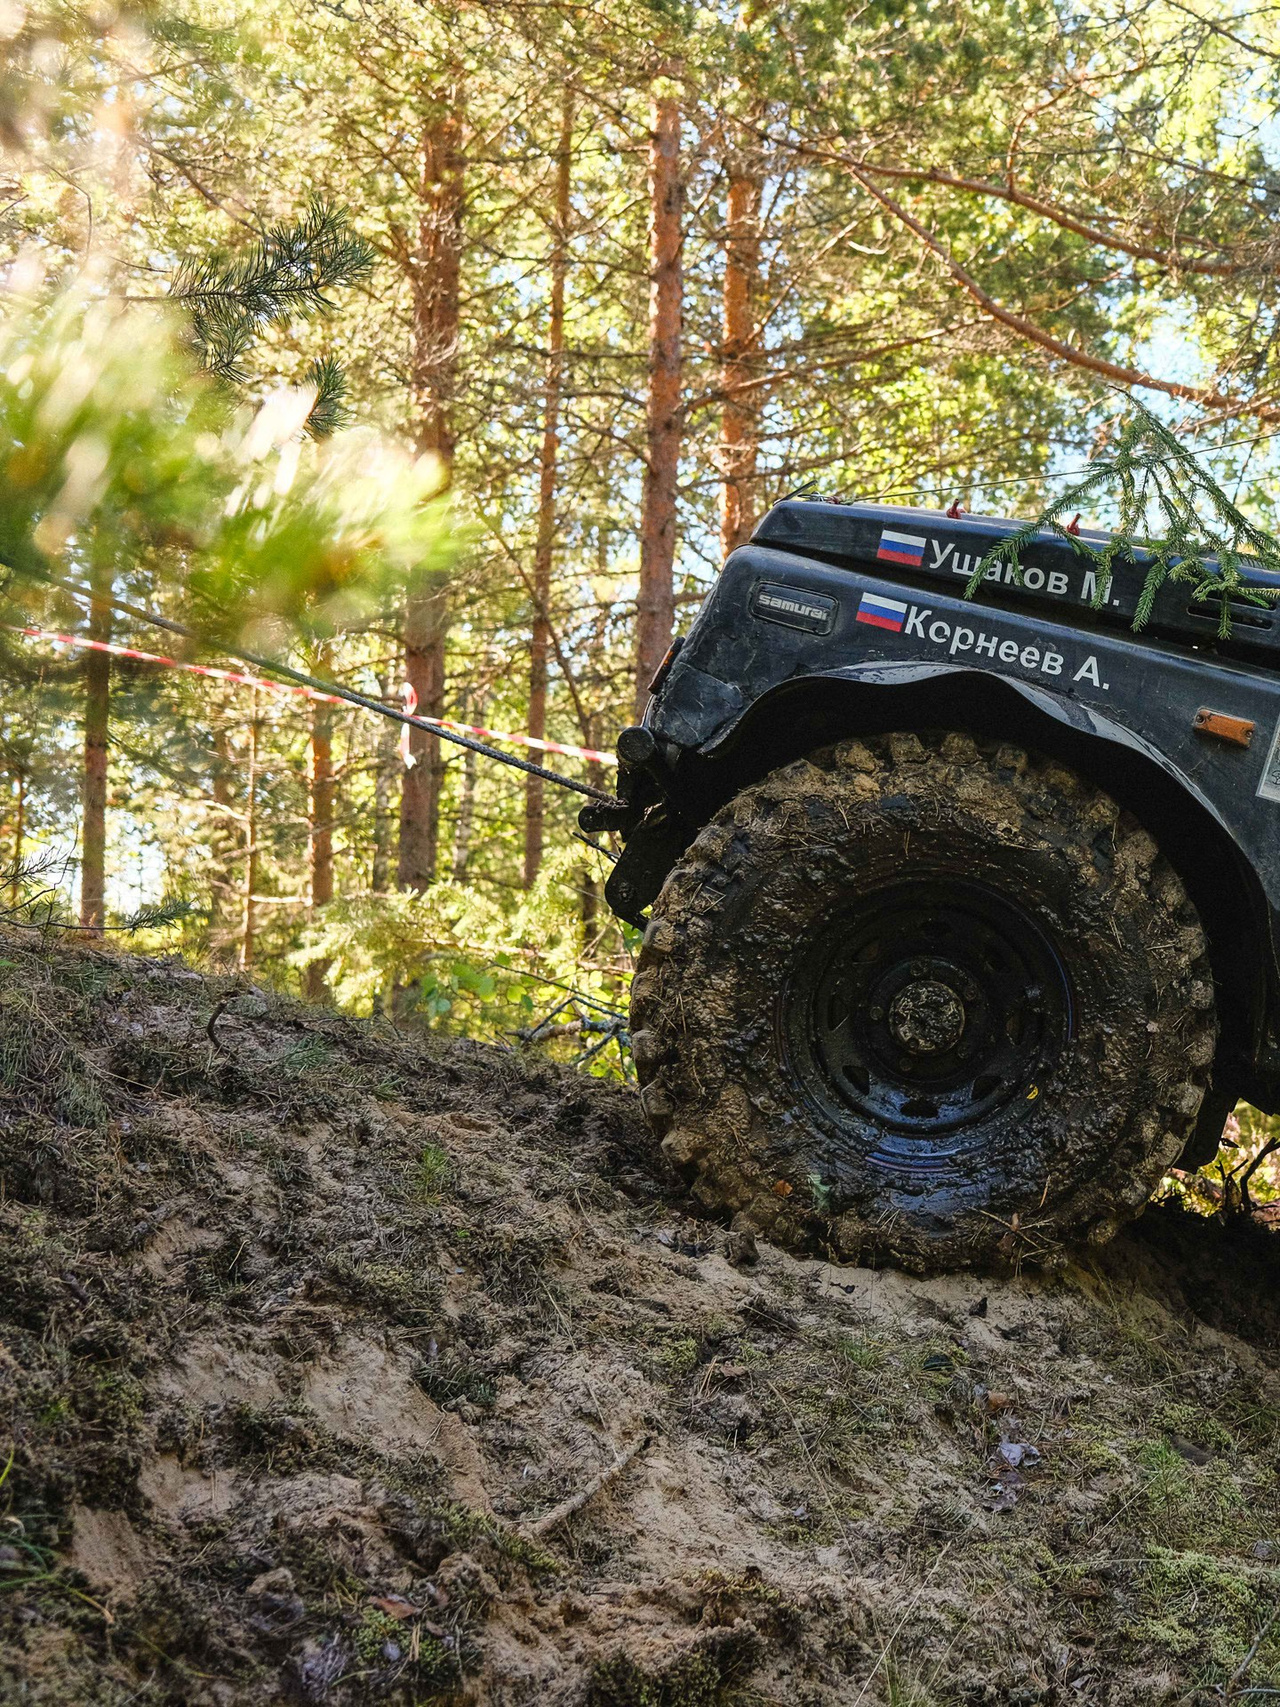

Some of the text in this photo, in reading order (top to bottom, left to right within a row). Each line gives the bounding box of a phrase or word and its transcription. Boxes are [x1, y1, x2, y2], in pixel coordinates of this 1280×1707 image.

[929, 539, 1068, 595] Ушаков
[758, 594, 827, 620] samurai
[904, 606, 1109, 690] Корнеев А.
